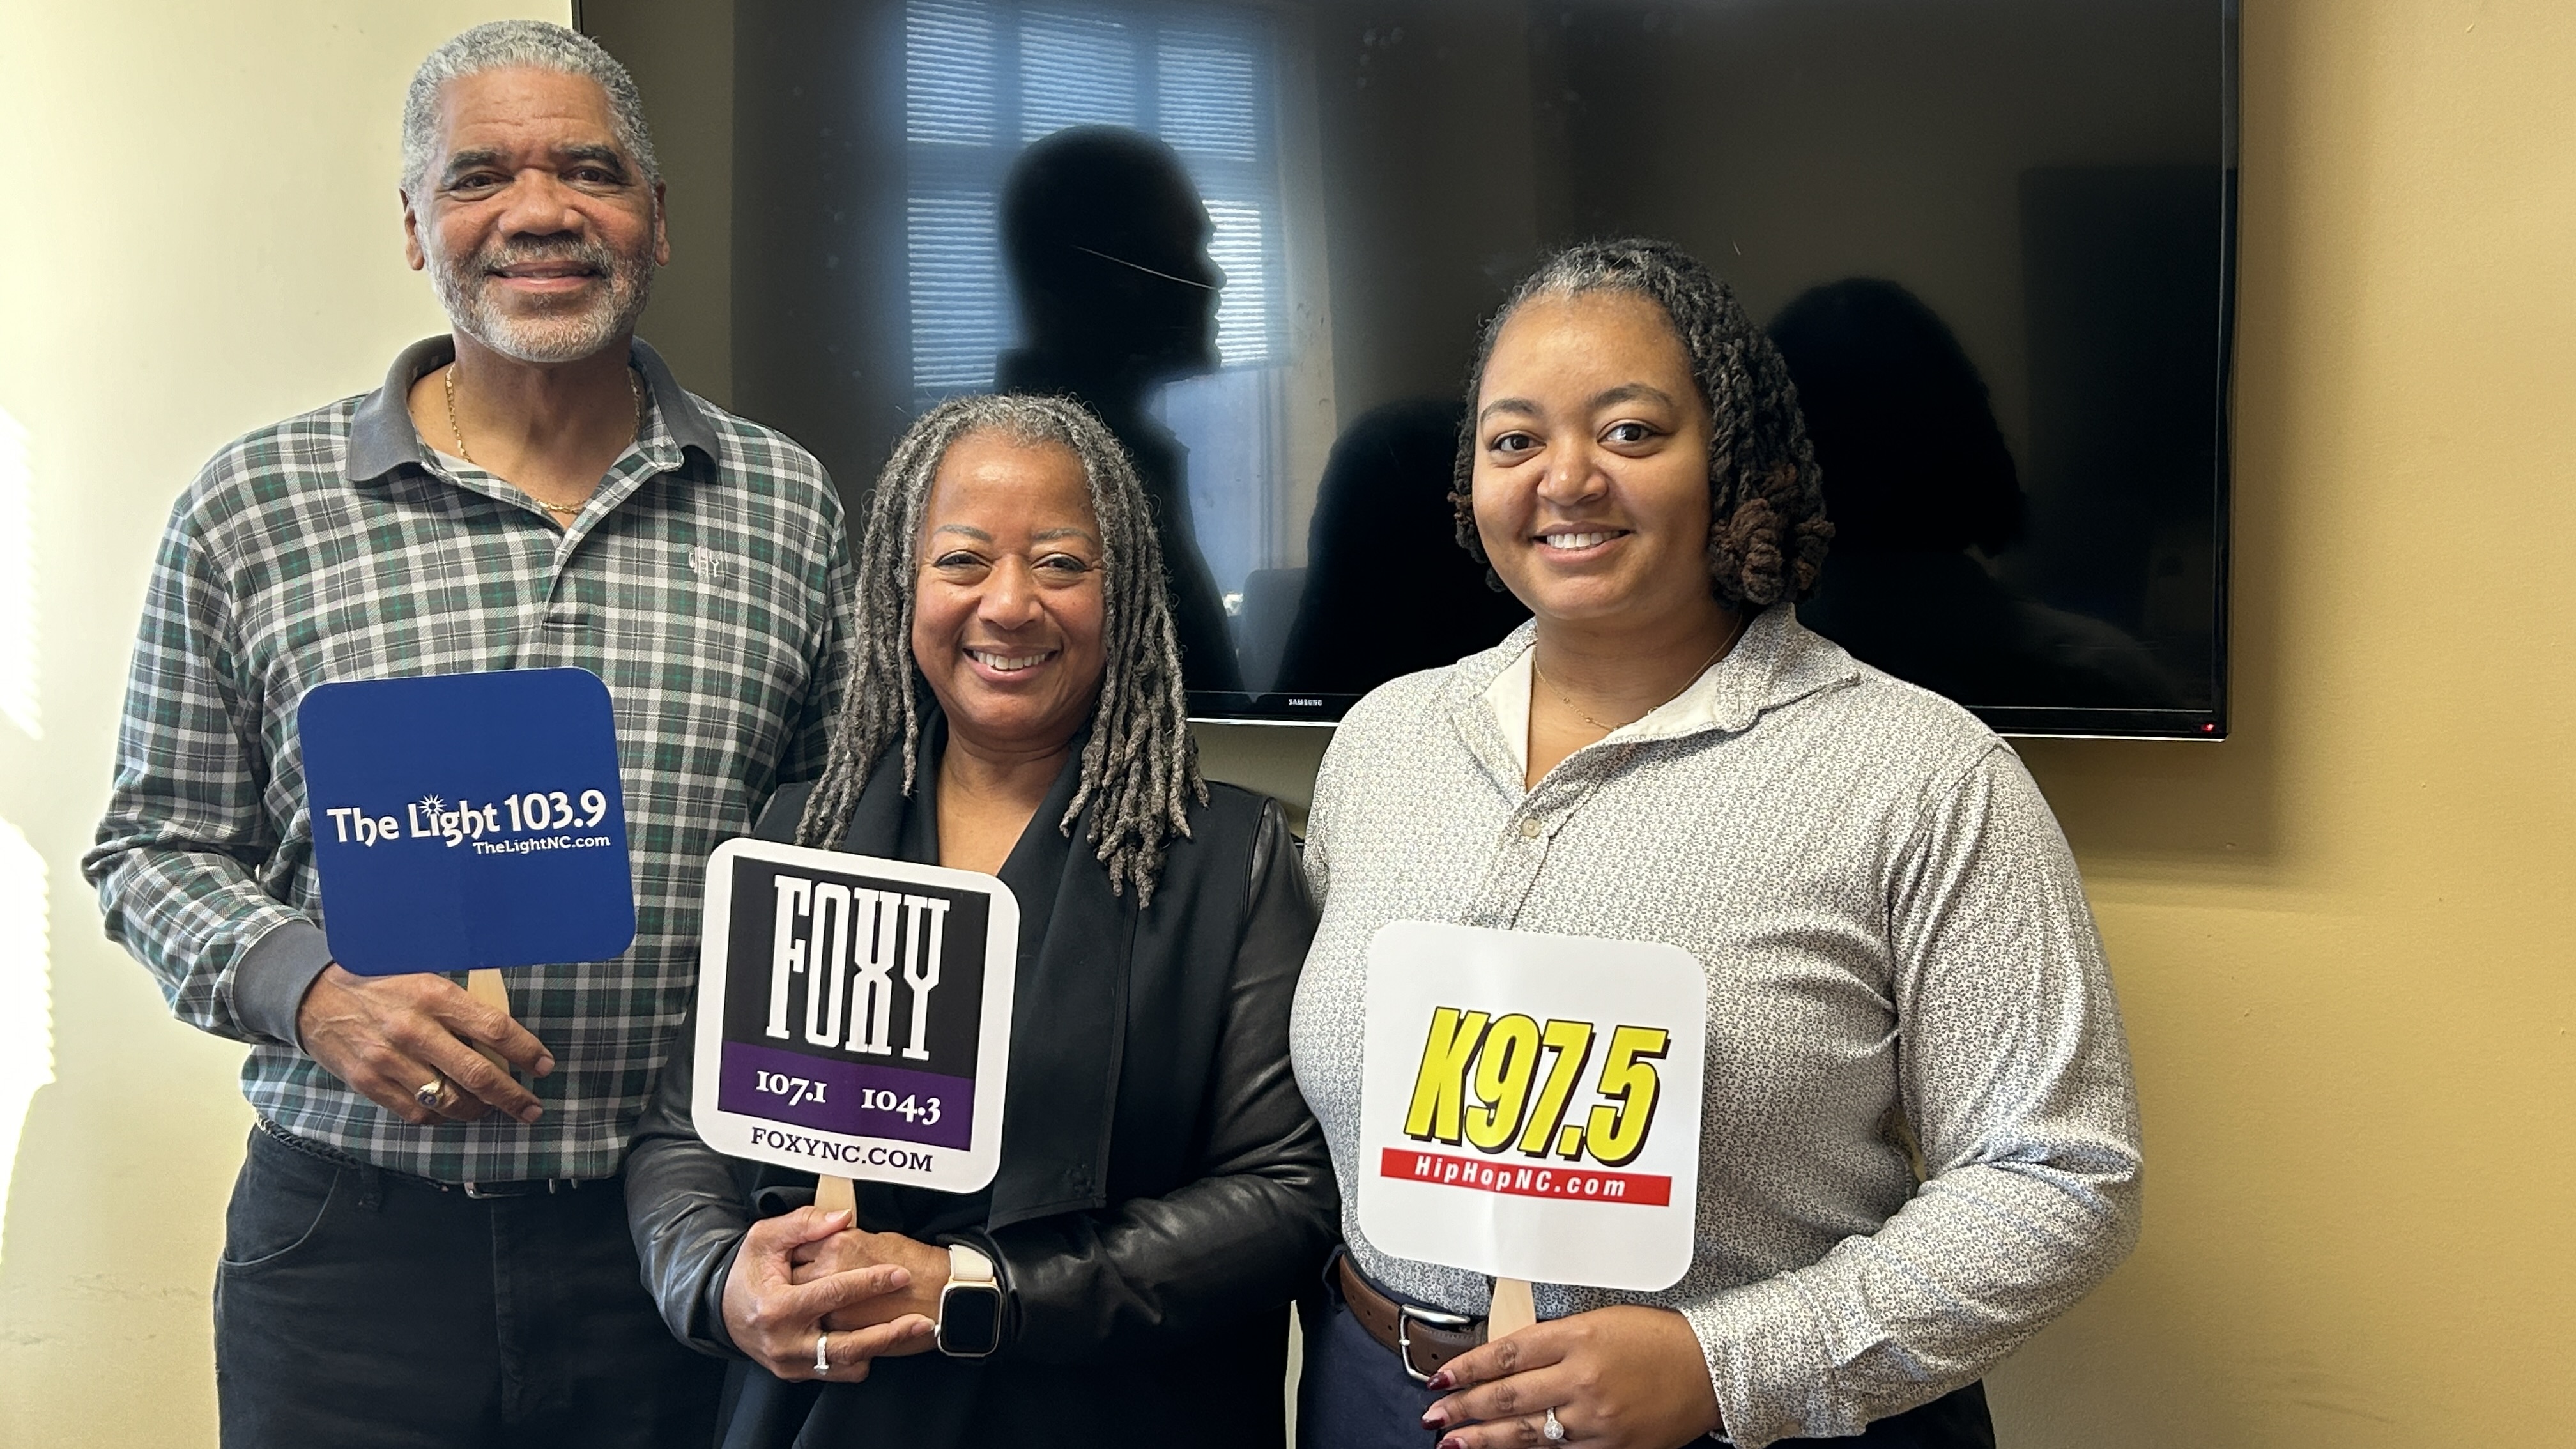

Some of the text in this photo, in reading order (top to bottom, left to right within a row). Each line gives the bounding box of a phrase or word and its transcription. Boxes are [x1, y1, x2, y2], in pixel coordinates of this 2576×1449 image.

[326, 789, 607, 848] The Light 103.9
[472, 836, 611, 855] TheLightNC.com
[765, 874, 951, 1061] FOXY
[756, 1070, 941, 1126] 107.1 104.3
[1403, 1006, 1671, 1168] K97.5
[750, 1126, 933, 1172] FOXYNC.COM
[1414, 1155, 1626, 1197] HipHopNC.com
